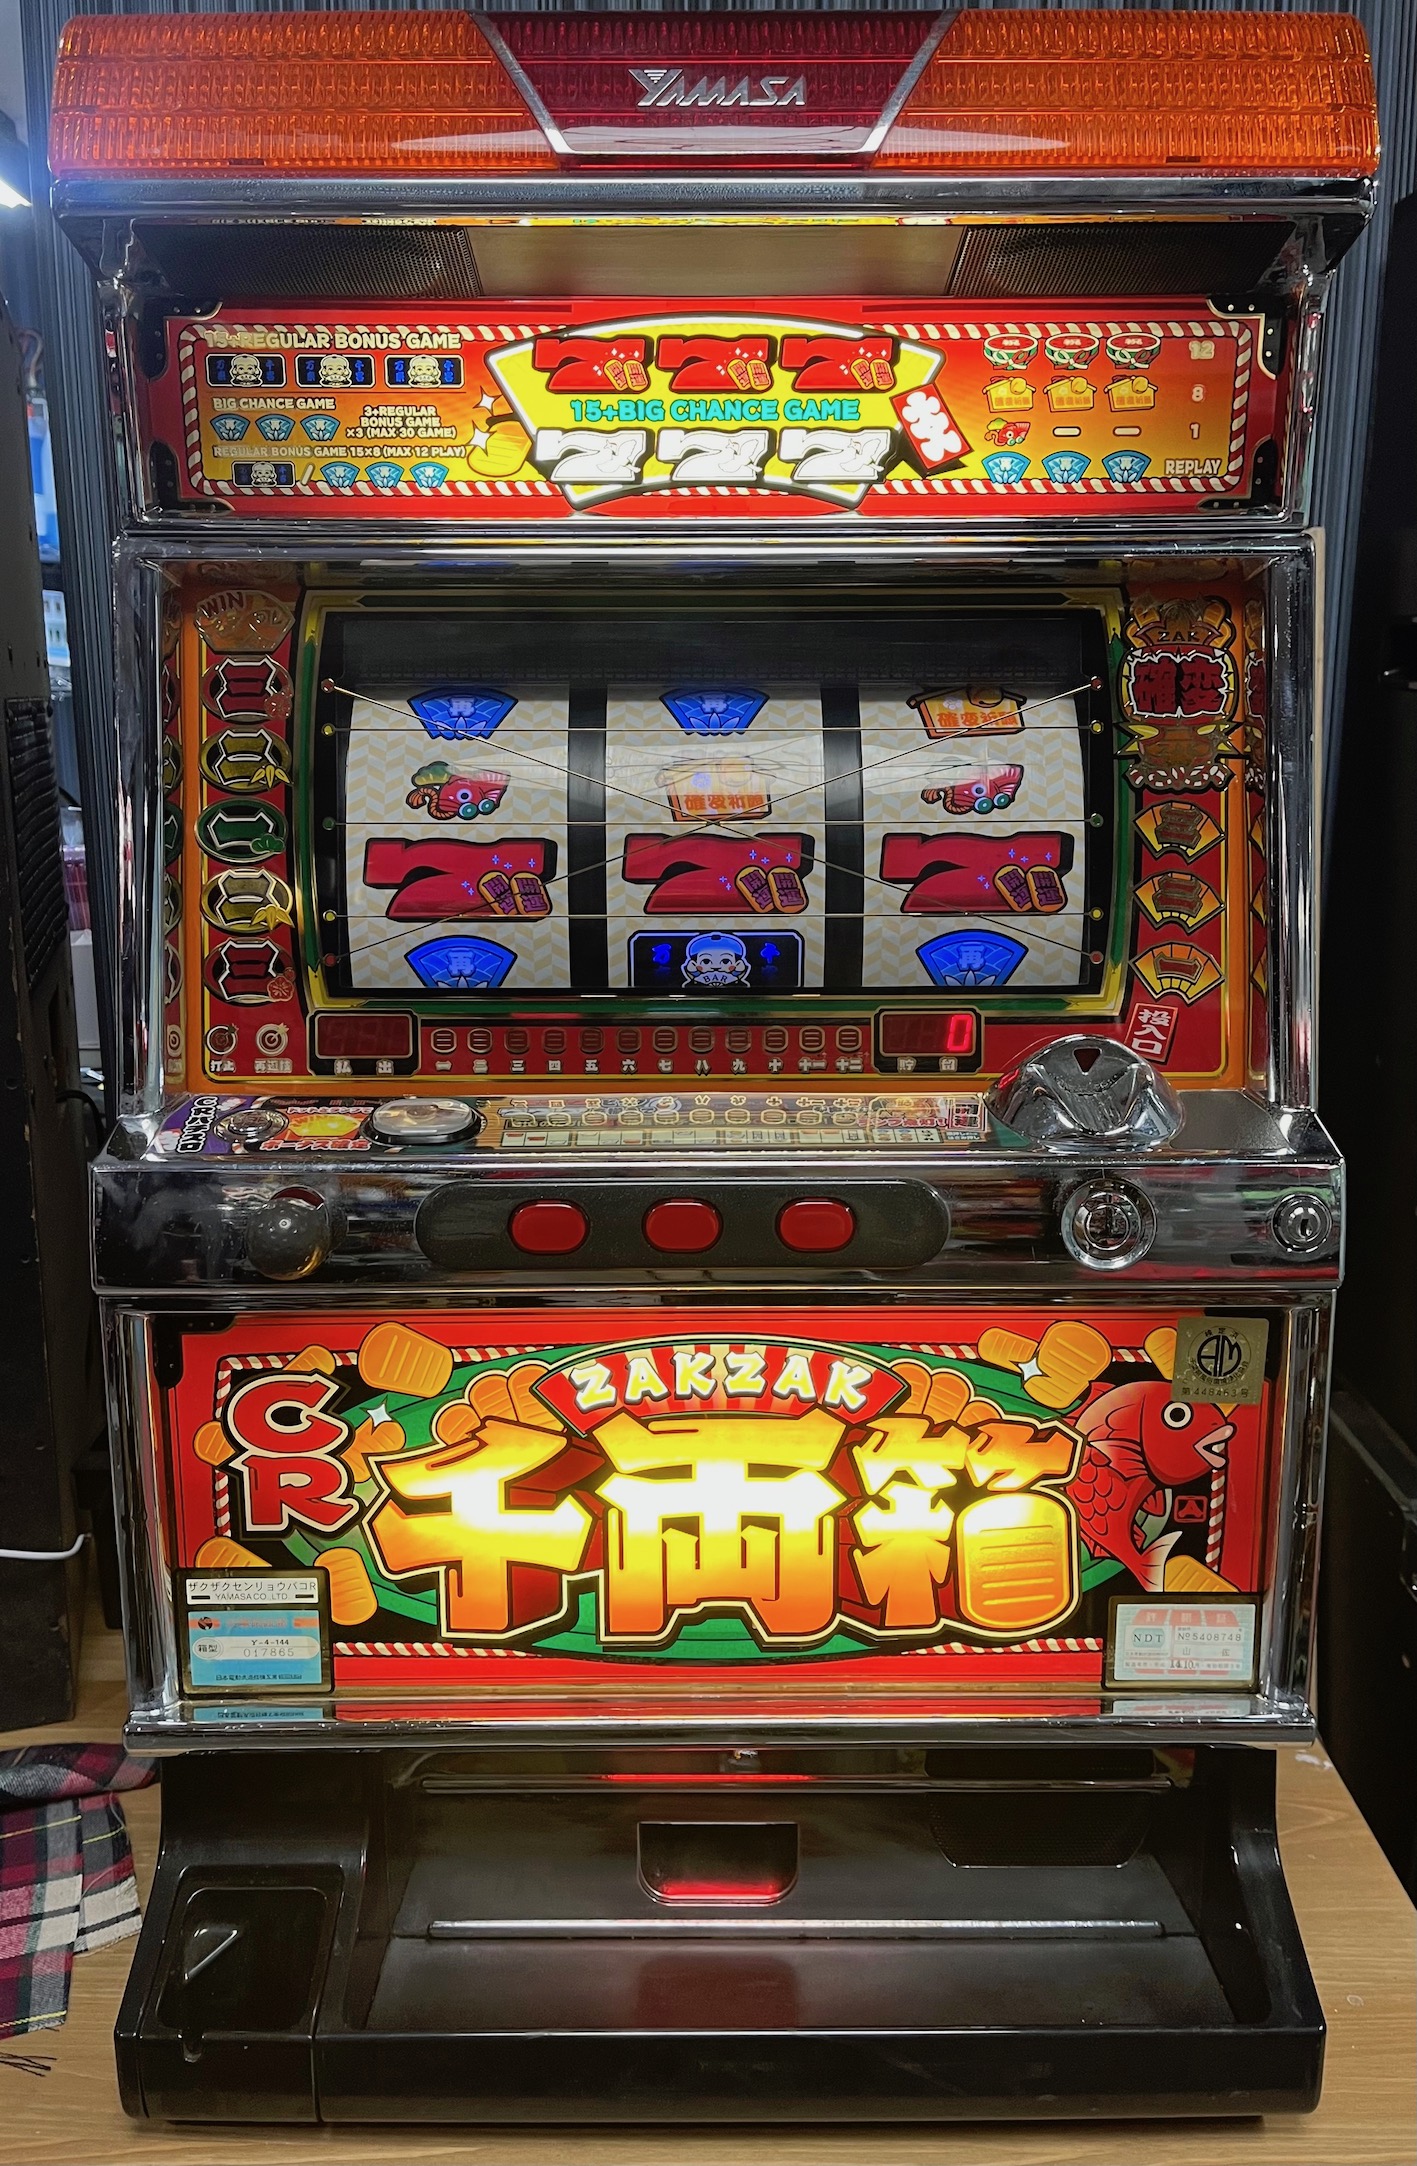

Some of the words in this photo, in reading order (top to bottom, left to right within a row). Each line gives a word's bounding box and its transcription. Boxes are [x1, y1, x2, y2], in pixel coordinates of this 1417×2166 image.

[628, 68, 806, 107] YAMASA
[205, 331, 330, 350] 15+REGULAR
[333, 333, 406, 350] BONUS
[407, 332, 462, 350] GAME
[1189, 341, 1215, 360] 12
[1192, 386, 1205, 402] 8
[213, 398, 240, 410] BIG
[240, 398, 297, 410] CHANCE
[297, 398, 336, 410] GAME
[364, 405, 437, 418] 3+REGULAR
[571, 400, 664, 422] 15+BIG
[674, 400, 779, 422] CHANCE
[783, 399, 860, 422] GAME
[361, 416, 404, 428] BONUS
[405, 416, 440, 428] GAME
[1191, 422, 1200, 439] 1
[366, 427, 397, 440] (MAX
[399, 427, 415, 439] 30
[416, 427, 456, 440] GAME)
[213, 446, 269, 458] REGULAR
[271, 446, 314, 458] BONUS
[314, 446, 348, 458] GAME
[383, 446, 413, 458] (MAX
[414, 446, 430, 458] 12
[431, 446, 466, 459] PLAY)
[1165, 459, 1221, 476] REPLAY
[200, 591, 245, 619] WIN
[1157, 630, 1200, 643] ZAK
[1133, 656, 1224, 714] 確変
[702, 973, 729, 983] BAR
[947, 1013, 974, 1052] 0
[1131, 1008, 1172, 1056] 投入口
[511, 1060, 525, 1073] 三
[548, 1060, 562, 1073] 四
[585, 1060, 599, 1073] 五
[622, 1059, 636, 1073] 六
[659, 1059, 673, 1072] 七
[696, 1059, 710, 1073] 八
[732, 1059, 747, 1072] 九
[768, 1058, 783, 1072] 十
[798, 1058, 827, 1072] 十一
[836, 1058, 863, 1073] 十二
[574, 1350, 873, 1411] ZAKZAK
[228, 1375, 360, 1530] CR
[374, 1412, 1077, 1634] 千両箱
[1132, 1633, 1165, 1644] NDT
[243, 1647, 295, 1658] 017865
